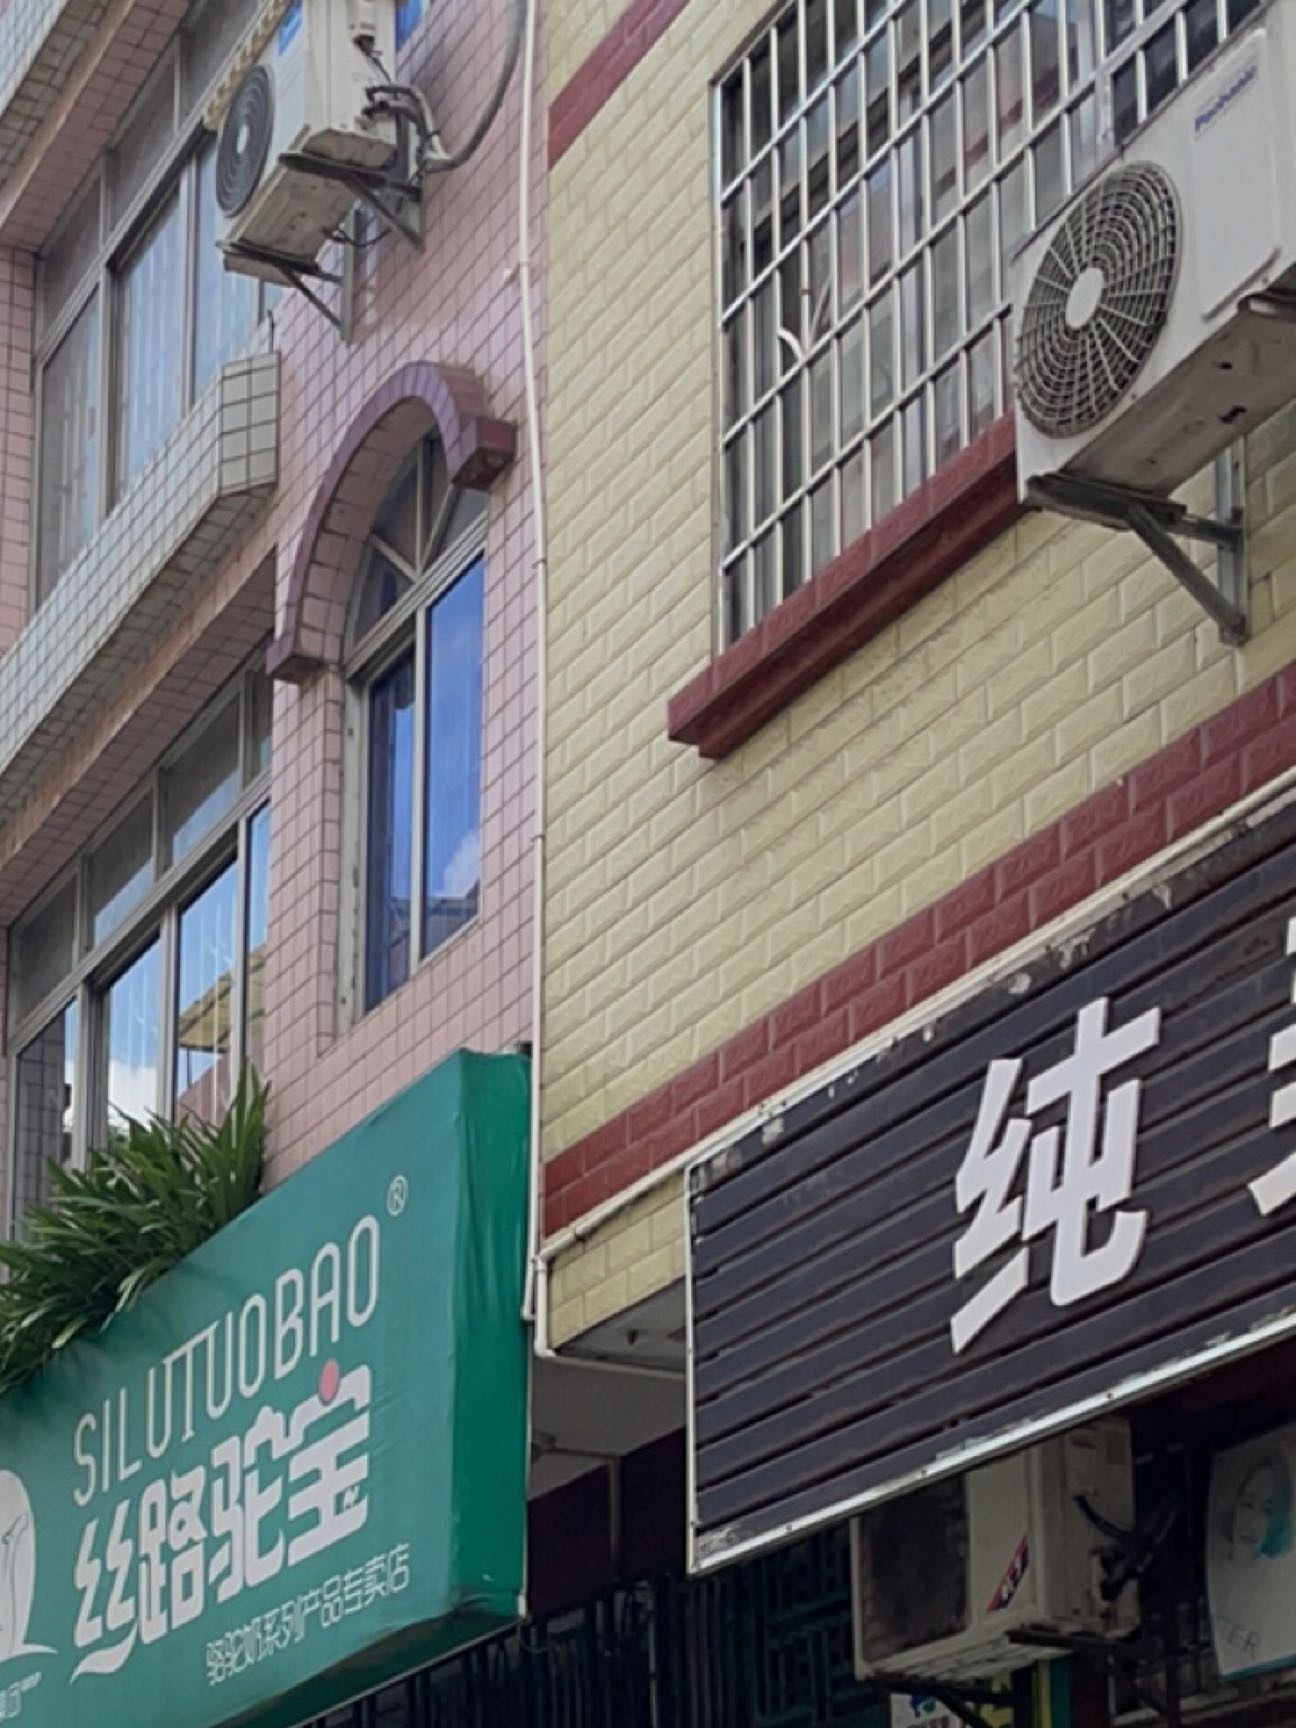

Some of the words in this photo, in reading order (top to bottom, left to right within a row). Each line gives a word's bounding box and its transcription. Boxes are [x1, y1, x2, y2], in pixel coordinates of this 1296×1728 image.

[72, 1213, 381, 1508] SILUTUOBAO
[70, 1358, 372, 1684] 丝路驼宝
